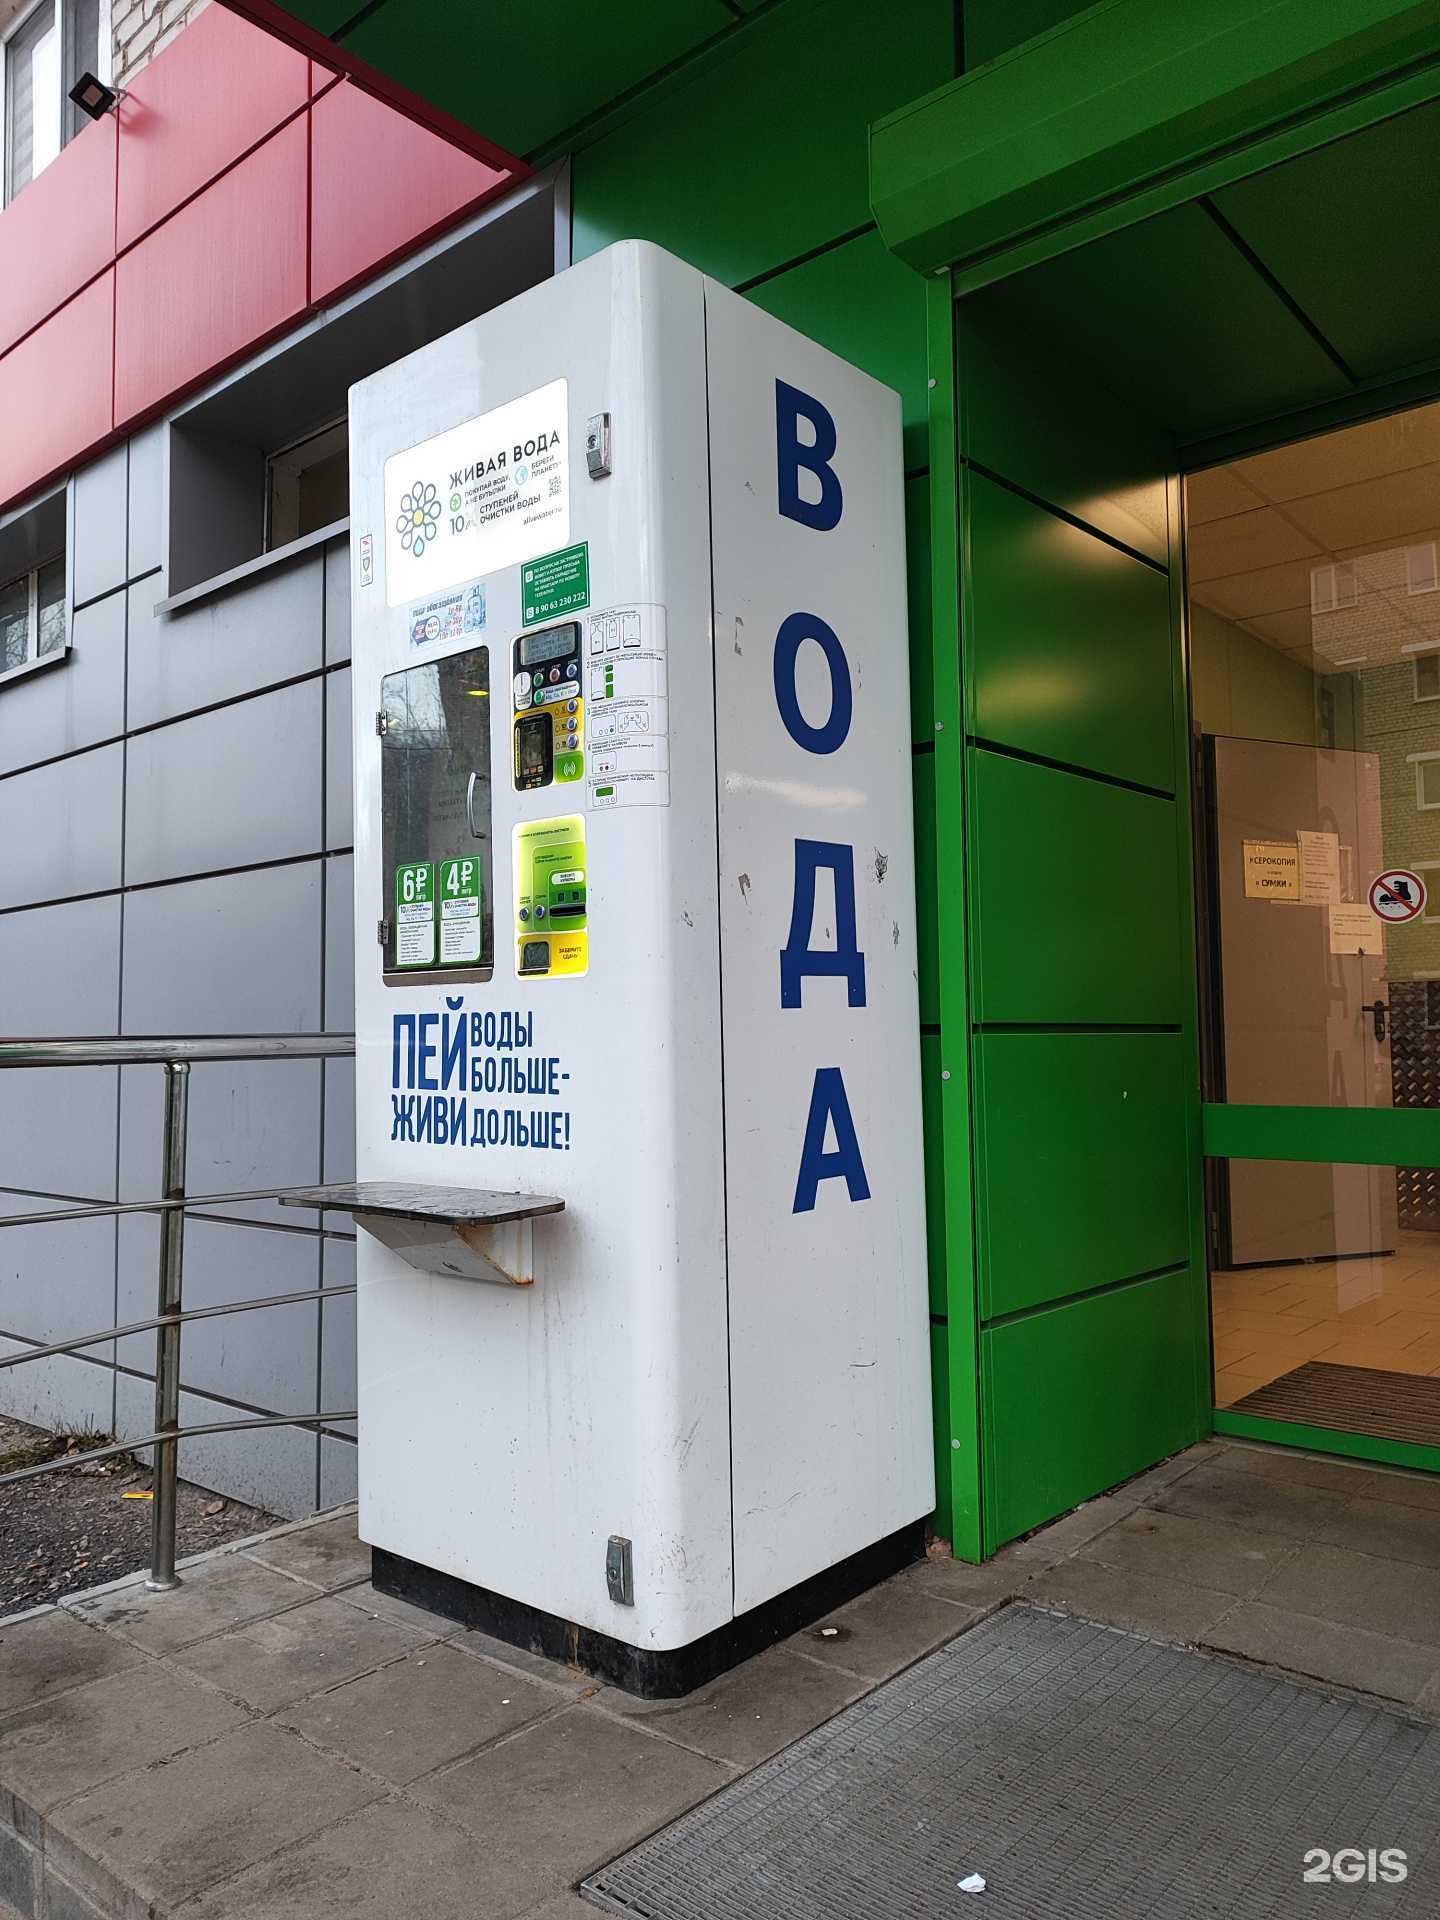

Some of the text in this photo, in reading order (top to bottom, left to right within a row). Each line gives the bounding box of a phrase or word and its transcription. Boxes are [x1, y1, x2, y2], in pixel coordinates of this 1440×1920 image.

[449, 430, 561, 490] ЖИВАЯ ВОДА
[479, 485, 506, 501] БУТЫЛКИ
[480, 491, 519, 514] СТУПЕНЕЙ
[480, 494, 541, 524] ОЧИСТКИ ВОДЫ
[535, 591, 586, 614] 8 90 63 230 222
[773, 377, 872, 1215] ВОДА
[1249, 856, 1296, 867] КСЕРОКОПИЯ
[392, 996, 533, 1091] ПЕЙ ВОДЫ
[471, 1056, 570, 1095] БОЛЬШЕ-
[391, 1094, 570, 1150] ЖИВИ ДОЛЬШЕ!
